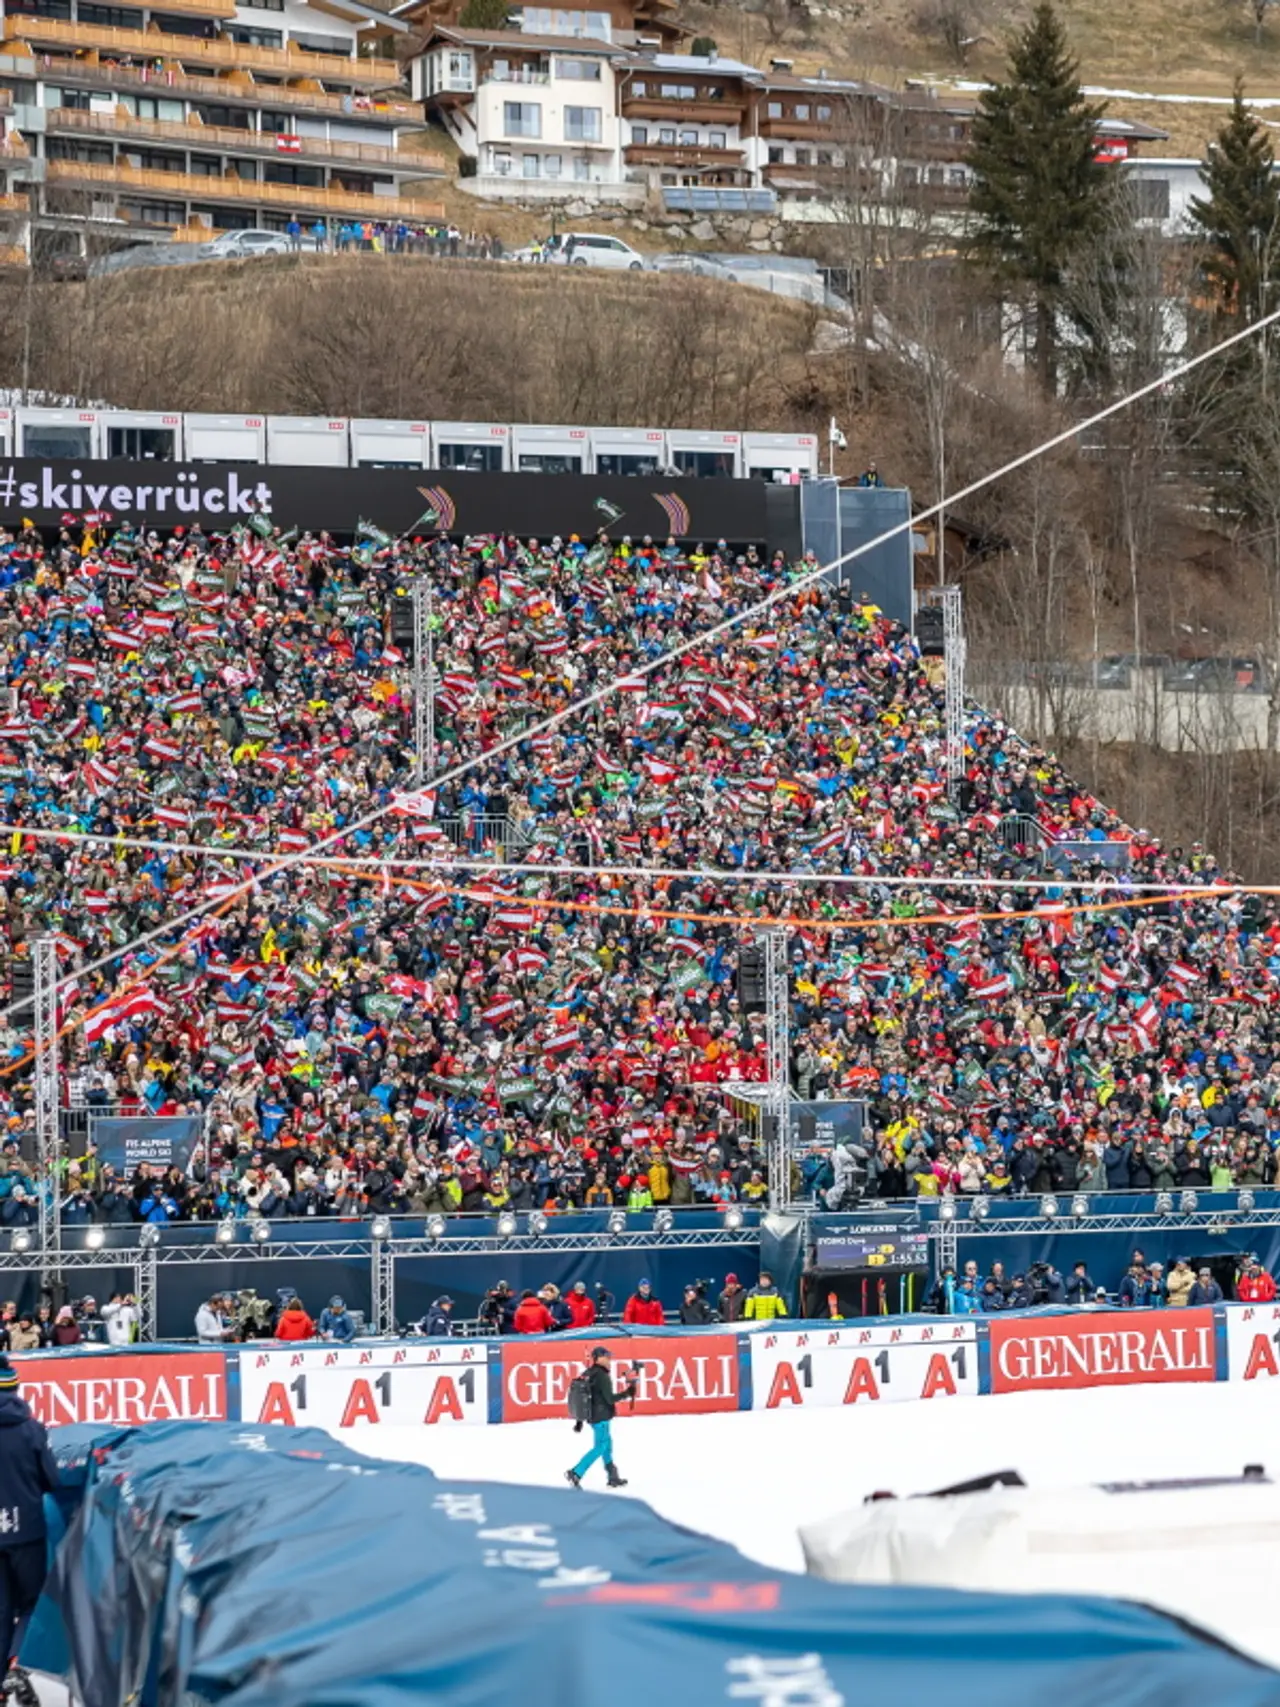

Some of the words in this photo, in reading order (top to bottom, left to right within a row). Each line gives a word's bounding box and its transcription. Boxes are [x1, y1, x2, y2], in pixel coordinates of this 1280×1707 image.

[0, 466, 272, 513] #skiverrückt
[125, 1148, 157, 1158] WORLD
[766, 1354, 812, 1408] A1
[843, 1350, 890, 1404] A1
[920, 1346, 967, 1399] A1
[999, 1327, 1213, 1380] GENERALI
[17, 1373, 223, 1427] ENERALI
[257, 1374, 306, 1424] A1
[339, 1371, 391, 1427] A1
[424, 1368, 474, 1424] A1
[507, 1355, 736, 1406] GEERALI
